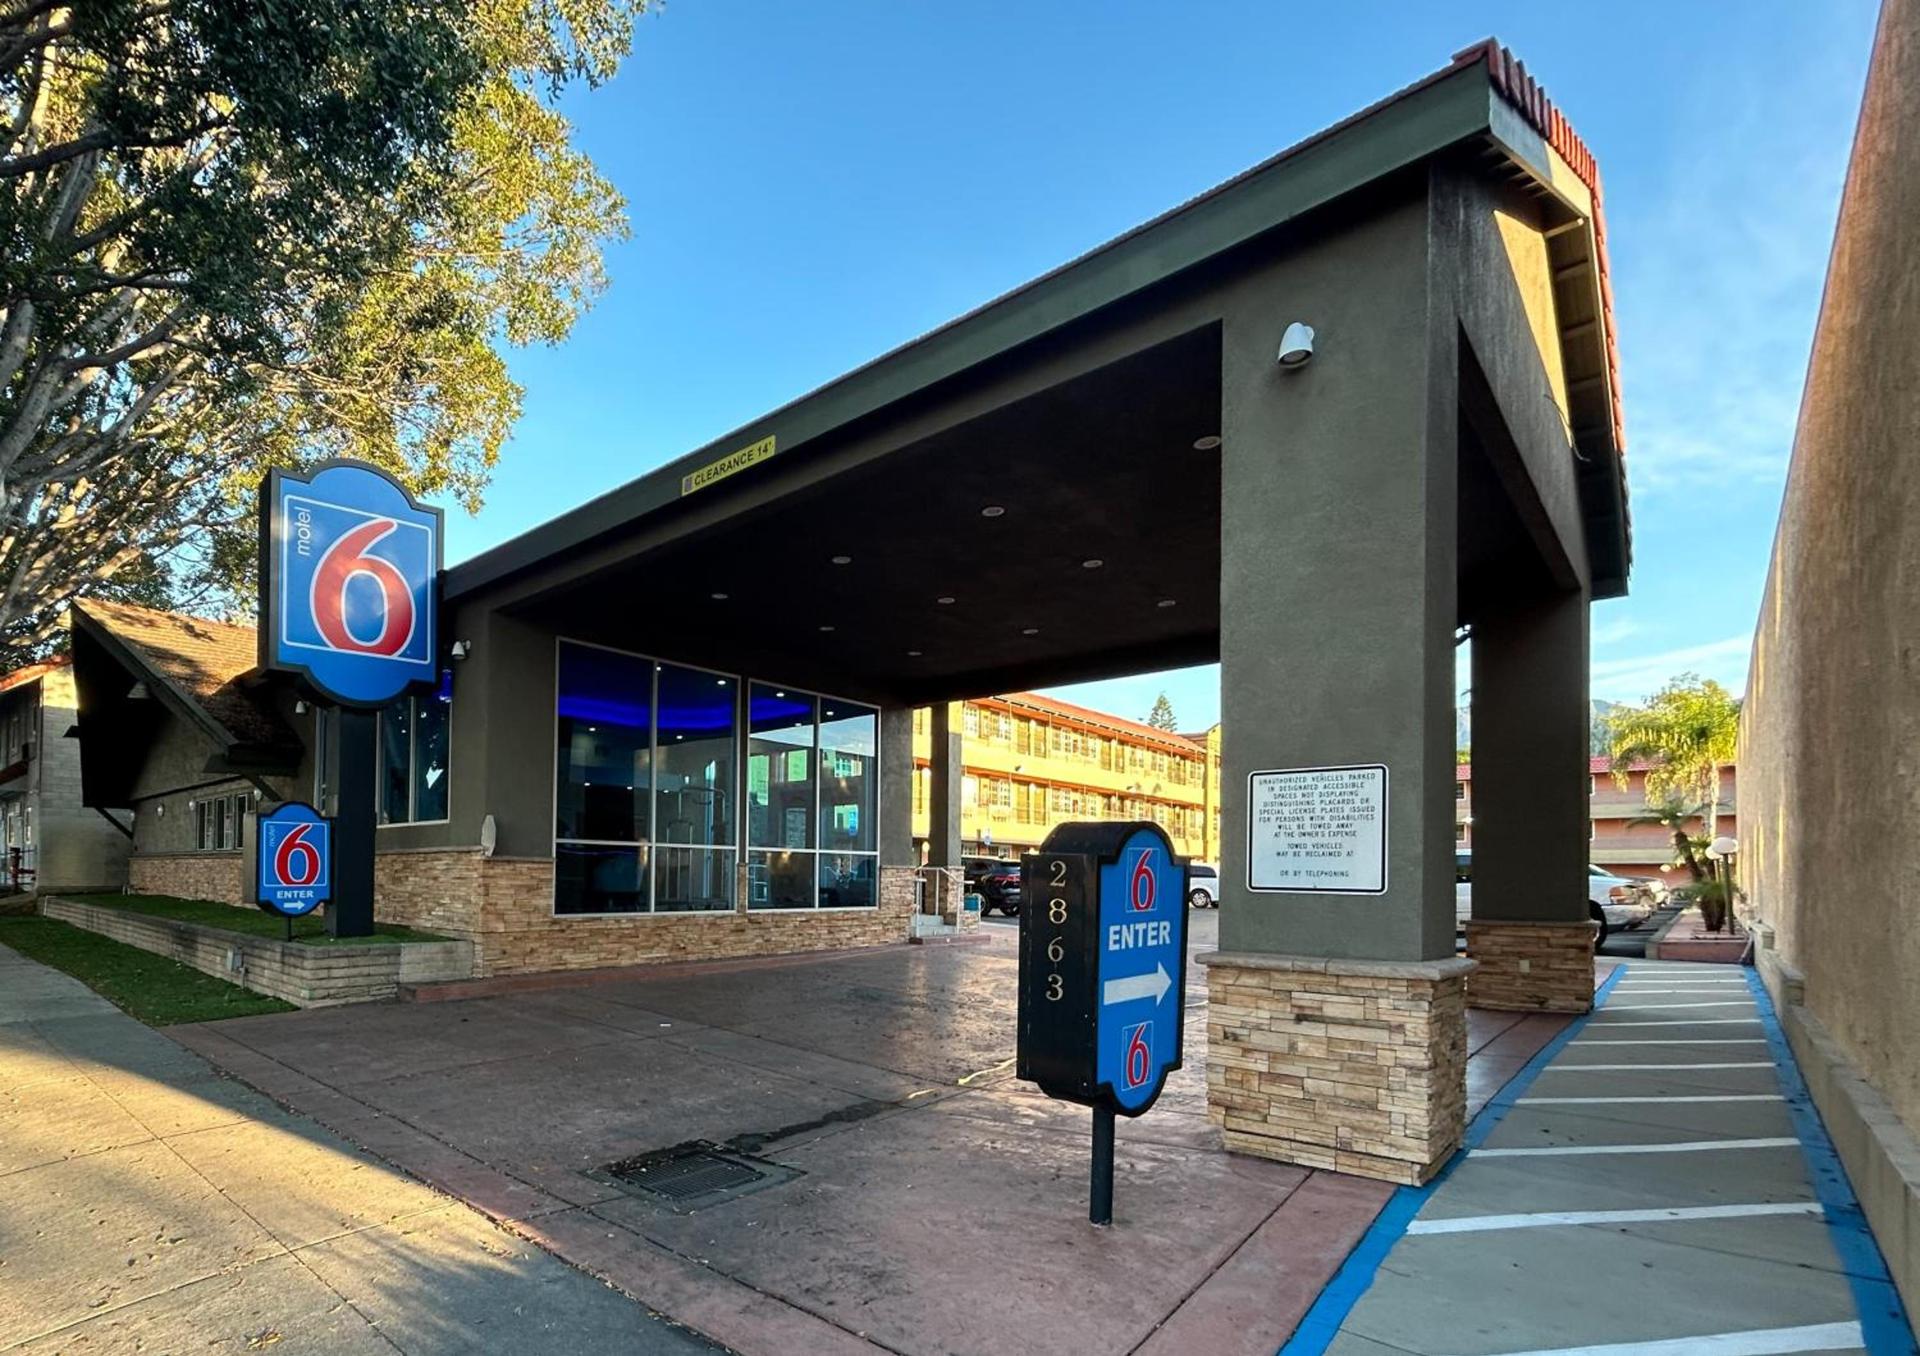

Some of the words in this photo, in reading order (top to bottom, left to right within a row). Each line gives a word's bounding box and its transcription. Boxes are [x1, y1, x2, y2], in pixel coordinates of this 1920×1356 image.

[694, 450, 754, 486] CLEARANCE
[294, 506, 311, 556] motel
[309, 517, 416, 658] 6
[274, 823, 320, 886] 6
[1131, 848, 1155, 912] 6
[277, 890, 314, 899] ENTER
[1046, 860, 1068, 1001] 2863
[1108, 920, 1171, 950] ENTER
[1126, 1024, 1150, 1088] 6
